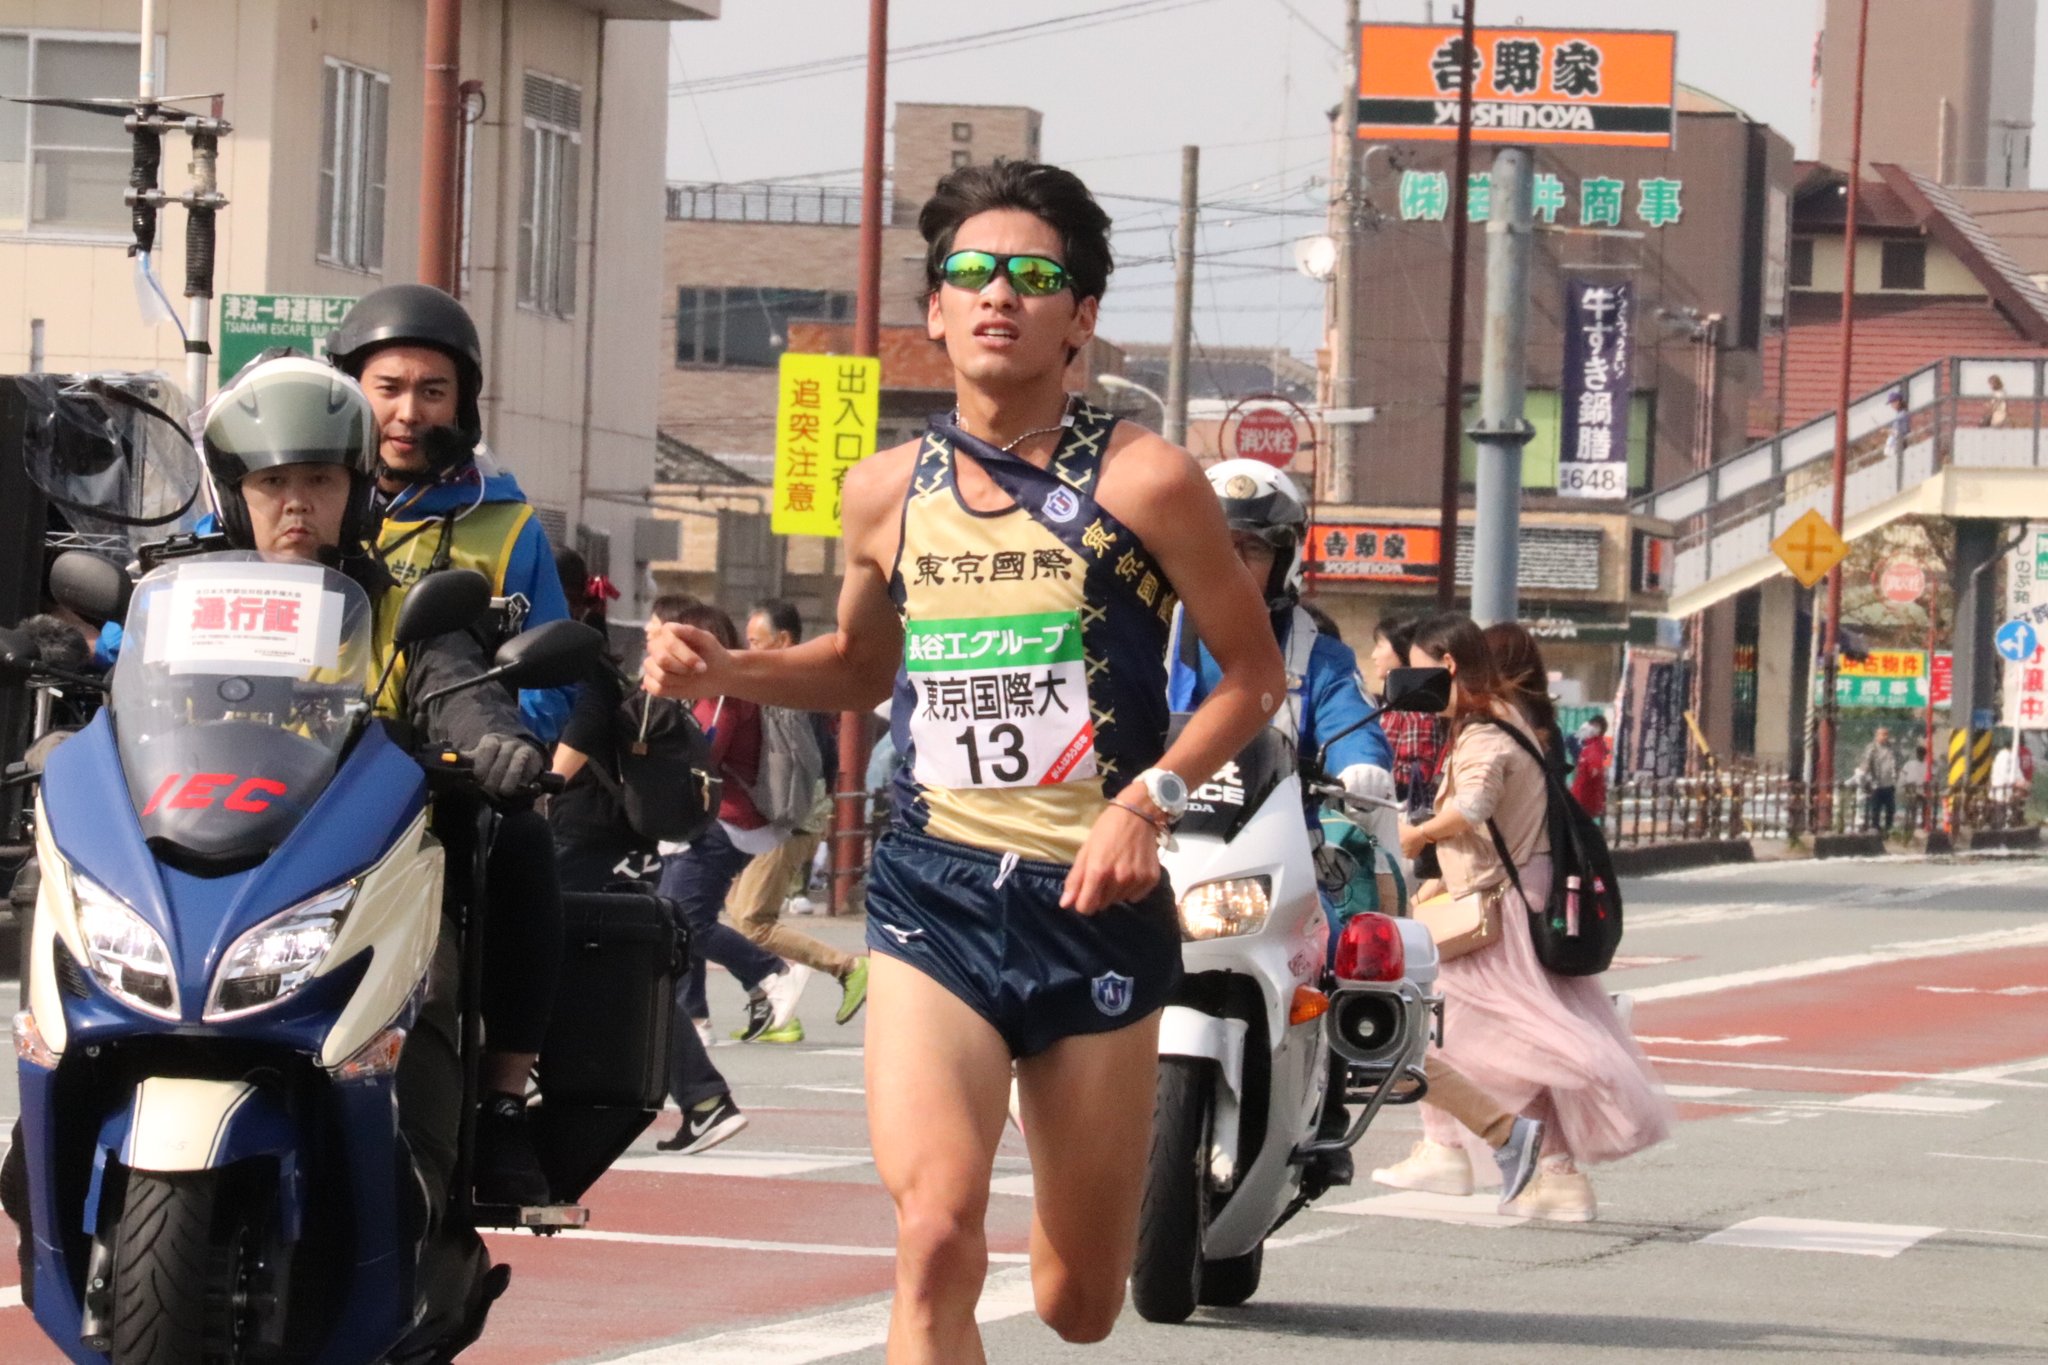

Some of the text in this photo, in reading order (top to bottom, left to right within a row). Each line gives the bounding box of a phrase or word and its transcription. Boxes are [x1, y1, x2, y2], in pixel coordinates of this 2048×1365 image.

[225, 321, 267, 335] TSUNAMI
[271, 323, 307, 337] ESCAPE
[784, 378, 821, 512] 追突注意
[1241, 428, 1293, 454] 消火栓
[1569, 468, 1616, 491] 648
[913, 548, 1073, 587] 東京國際
[191, 596, 301, 633] 通行証
[908, 622, 1071, 661] 長谷工グループ
[922, 670, 1069, 722] 東京国際大
[956, 723, 1029, 785] 13
